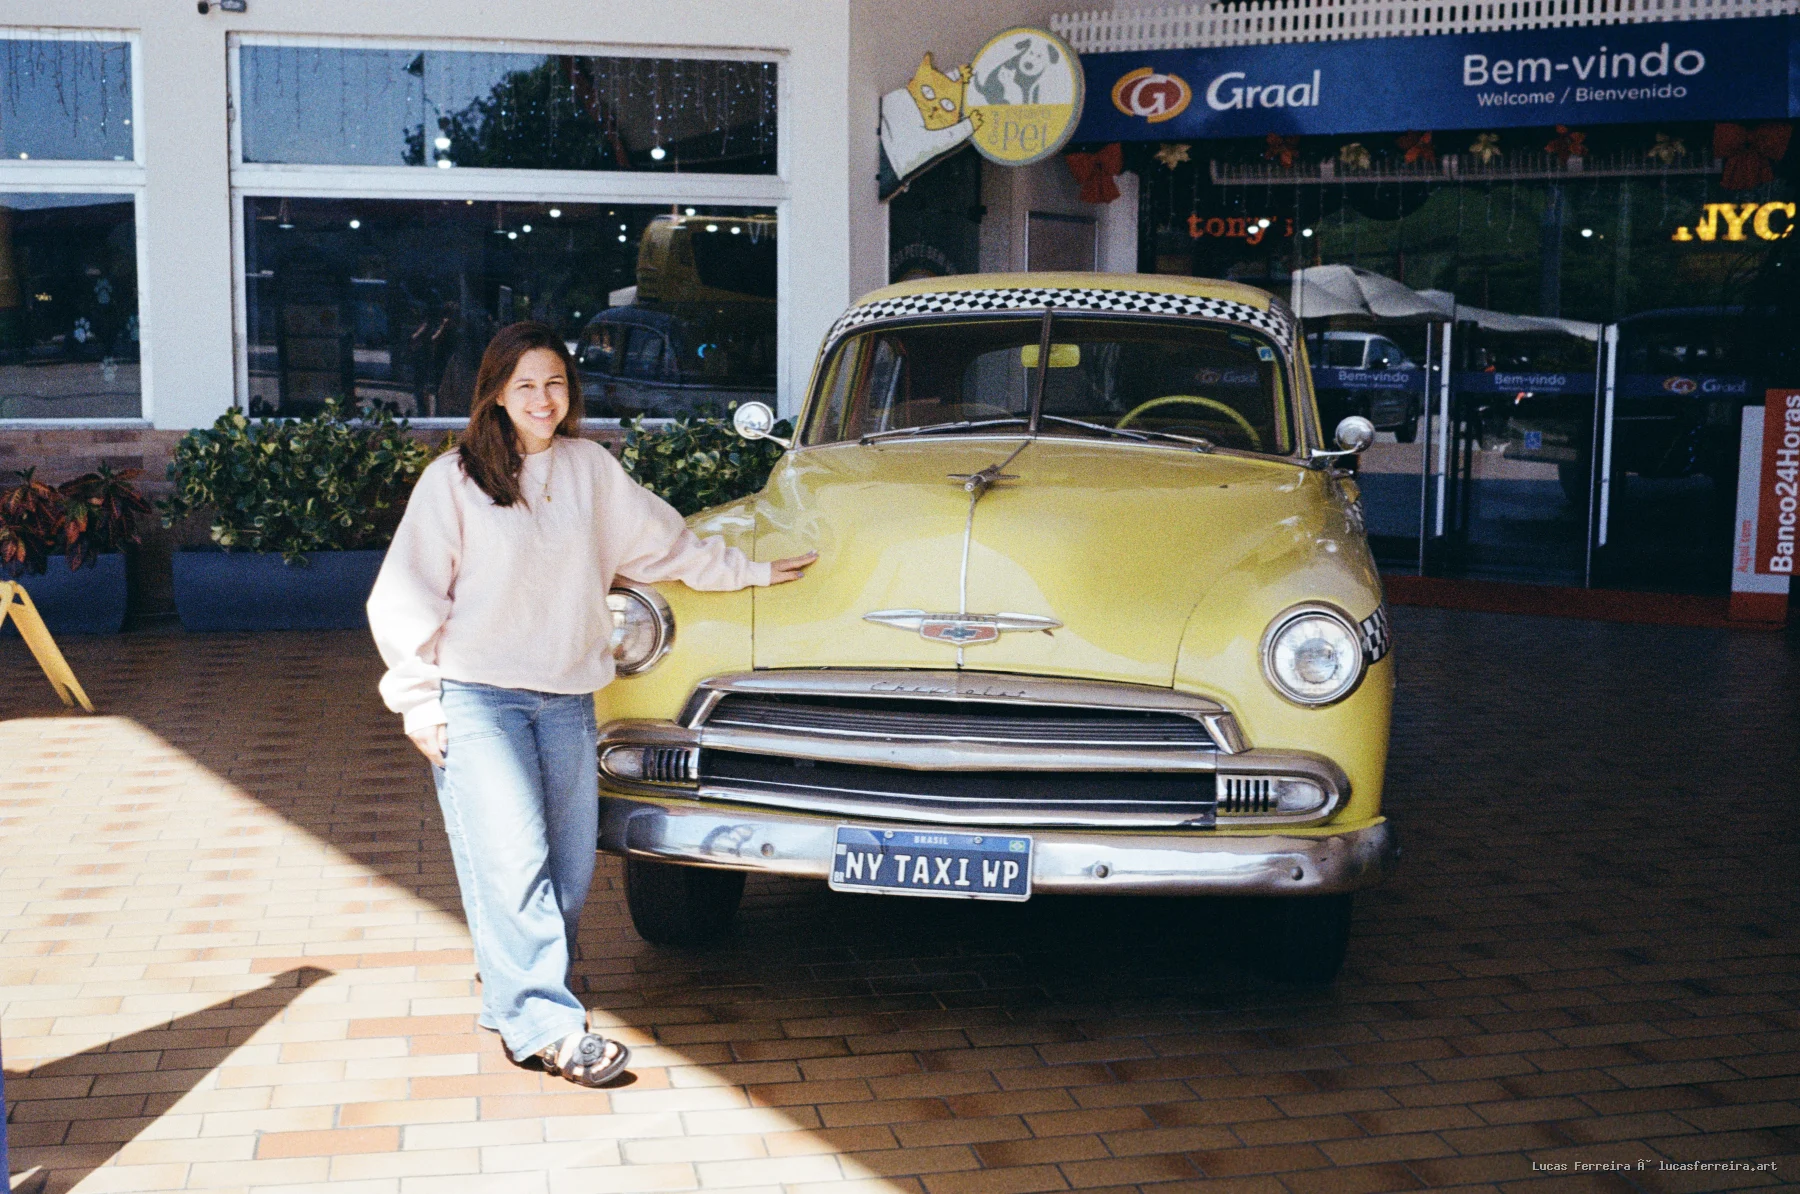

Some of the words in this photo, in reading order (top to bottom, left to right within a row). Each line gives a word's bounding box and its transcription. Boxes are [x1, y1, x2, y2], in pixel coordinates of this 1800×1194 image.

[1463, 42, 1706, 86] Bem-vindo
[1206, 69, 1321, 112] Graal
[1477, 90, 1555, 107] Welcome
[1576, 84, 1687, 103] Bienvenido
[1338, 370, 1409, 383] Bem-vindo
[1494, 373, 1567, 385] Bem-vindo
[1770, 394, 1800, 573] Banco24Horas
[913, 835, 949, 845] BRASIL
[845, 851, 884, 881] NY
[894, 854, 970, 886] TAXI
[982, 859, 1019, 888] WP
